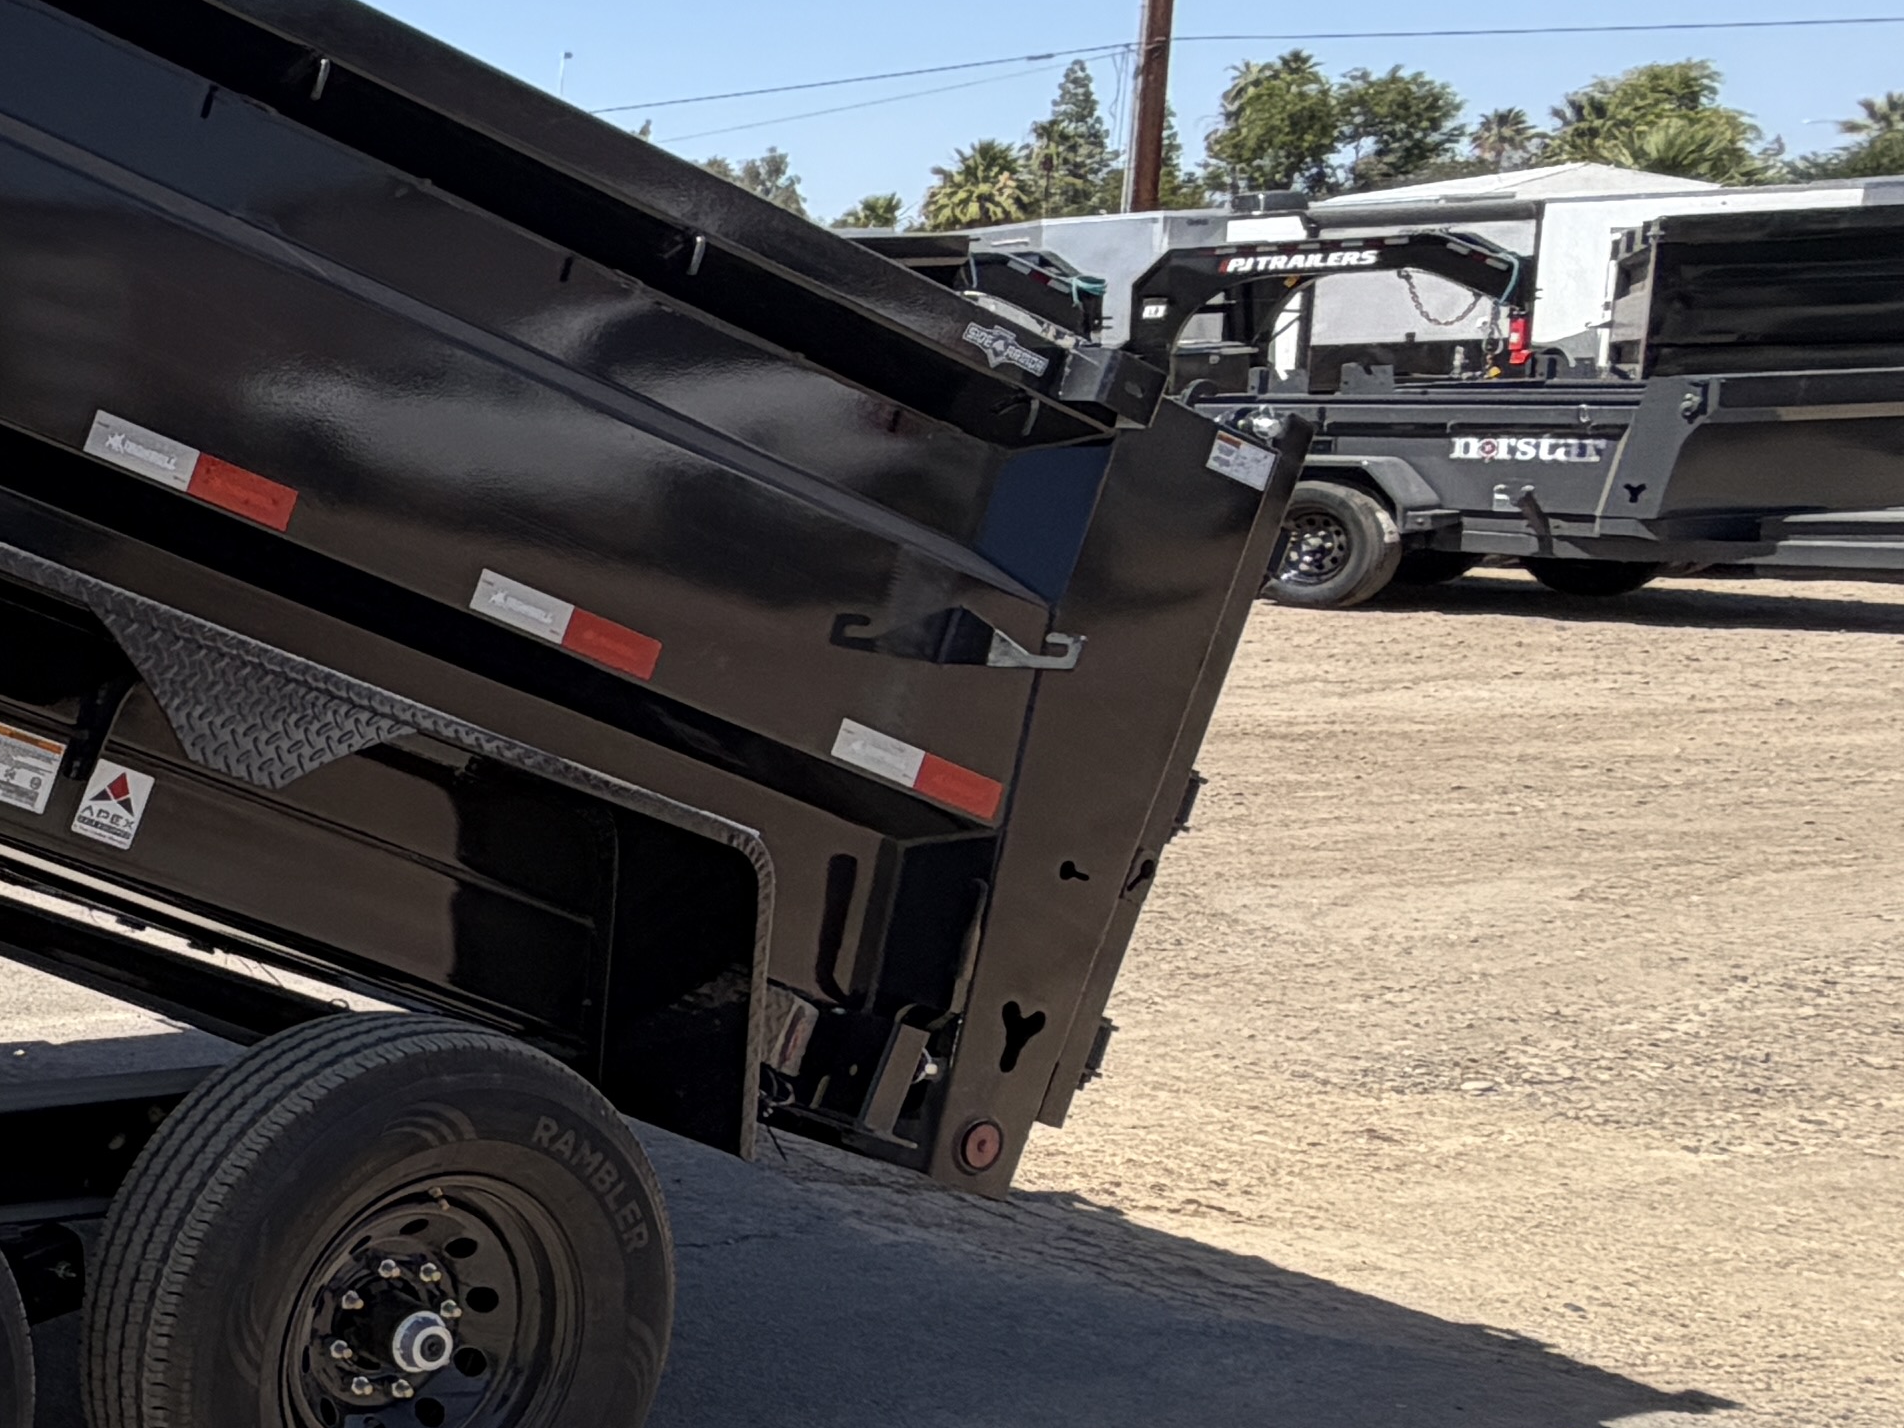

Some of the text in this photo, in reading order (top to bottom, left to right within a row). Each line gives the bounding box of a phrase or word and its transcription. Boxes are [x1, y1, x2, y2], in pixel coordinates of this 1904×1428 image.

[1226, 250, 1380, 273] PJ TRAILERS
[80, 804, 135, 829] APEX
[530, 1114, 650, 1256] RAMBLER
